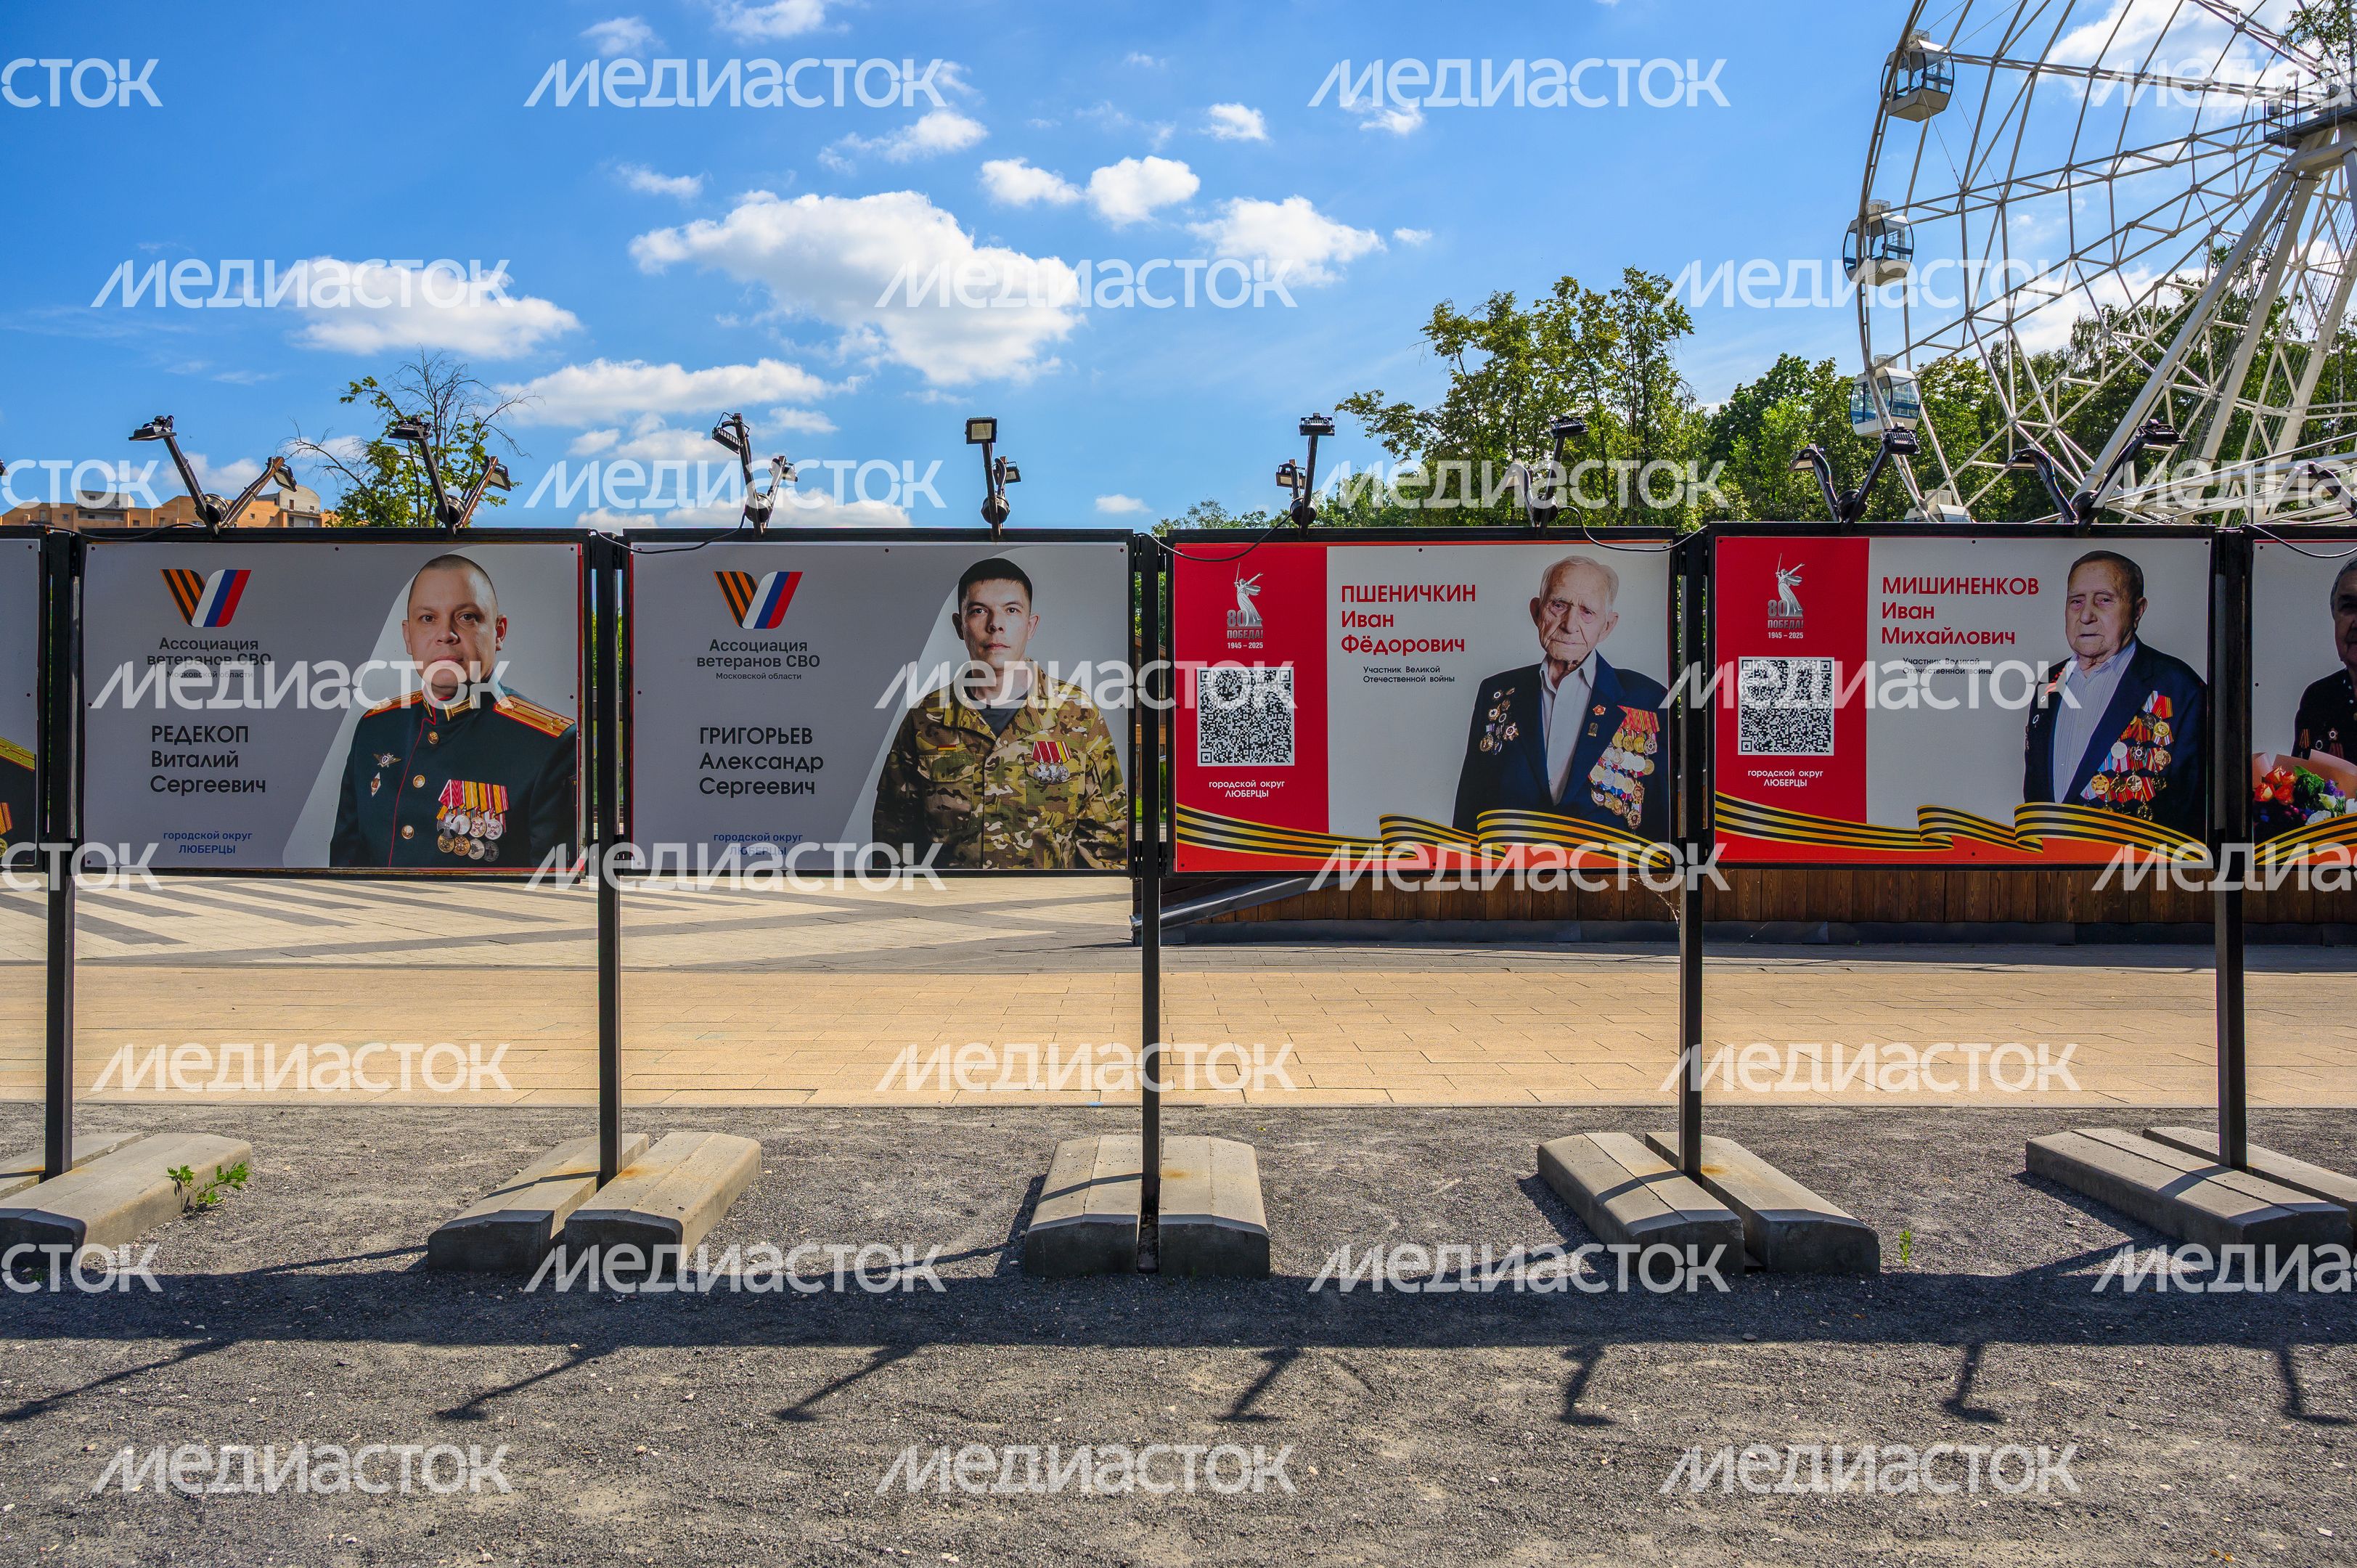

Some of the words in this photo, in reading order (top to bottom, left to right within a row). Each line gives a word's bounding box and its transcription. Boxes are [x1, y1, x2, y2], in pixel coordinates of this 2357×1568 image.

[1341, 584, 1476, 603] ПШЕНИЧКИН
[1882, 576, 2040, 595] МИШИНЕНКОВ
[1768, 599, 1789, 617] 80
[1882, 602, 1935, 619] Иван
[1227, 609, 1248, 627] 80
[1341, 611, 1394, 628] Иван
[1768, 619, 1804, 629] ПОБЕДА!
[1227, 629, 1264, 640] ПОБЕДА!
[1882, 626, 2015, 645] Михайлович
[159, 637, 258, 651] Ассоциация
[709, 639, 808, 653] Ассоциация
[1341, 634, 1465, 656] Фёдорович
[147, 654, 232, 668] ветеранов
[237, 653, 272, 666] СВО
[697, 657, 782, 670] ветеранов
[786, 655, 820, 667] СВО
[152, 725, 249, 746] РЕДЕКОП
[700, 727, 813, 745] ГРИГОРЬЕВ
[152, 750, 239, 767] Виталий
[699, 752, 824, 773] Александр
[150, 775, 266, 796] Сергеевич
[699, 777, 815, 798] Сергеевич
[1209, 780, 1257, 789] городской
[1763, 779, 1807, 788] ЛЮБЕРЦЫ
[1225, 790, 1269, 799] ЛЮБЕРЦЫ
[163, 831, 220, 841] городской
[222, 833, 253, 841] округ
[714, 833, 770, 843] городской
[772, 834, 803, 843] округ
[179, 845, 236, 854] ЛЮБЕРЦЫ
